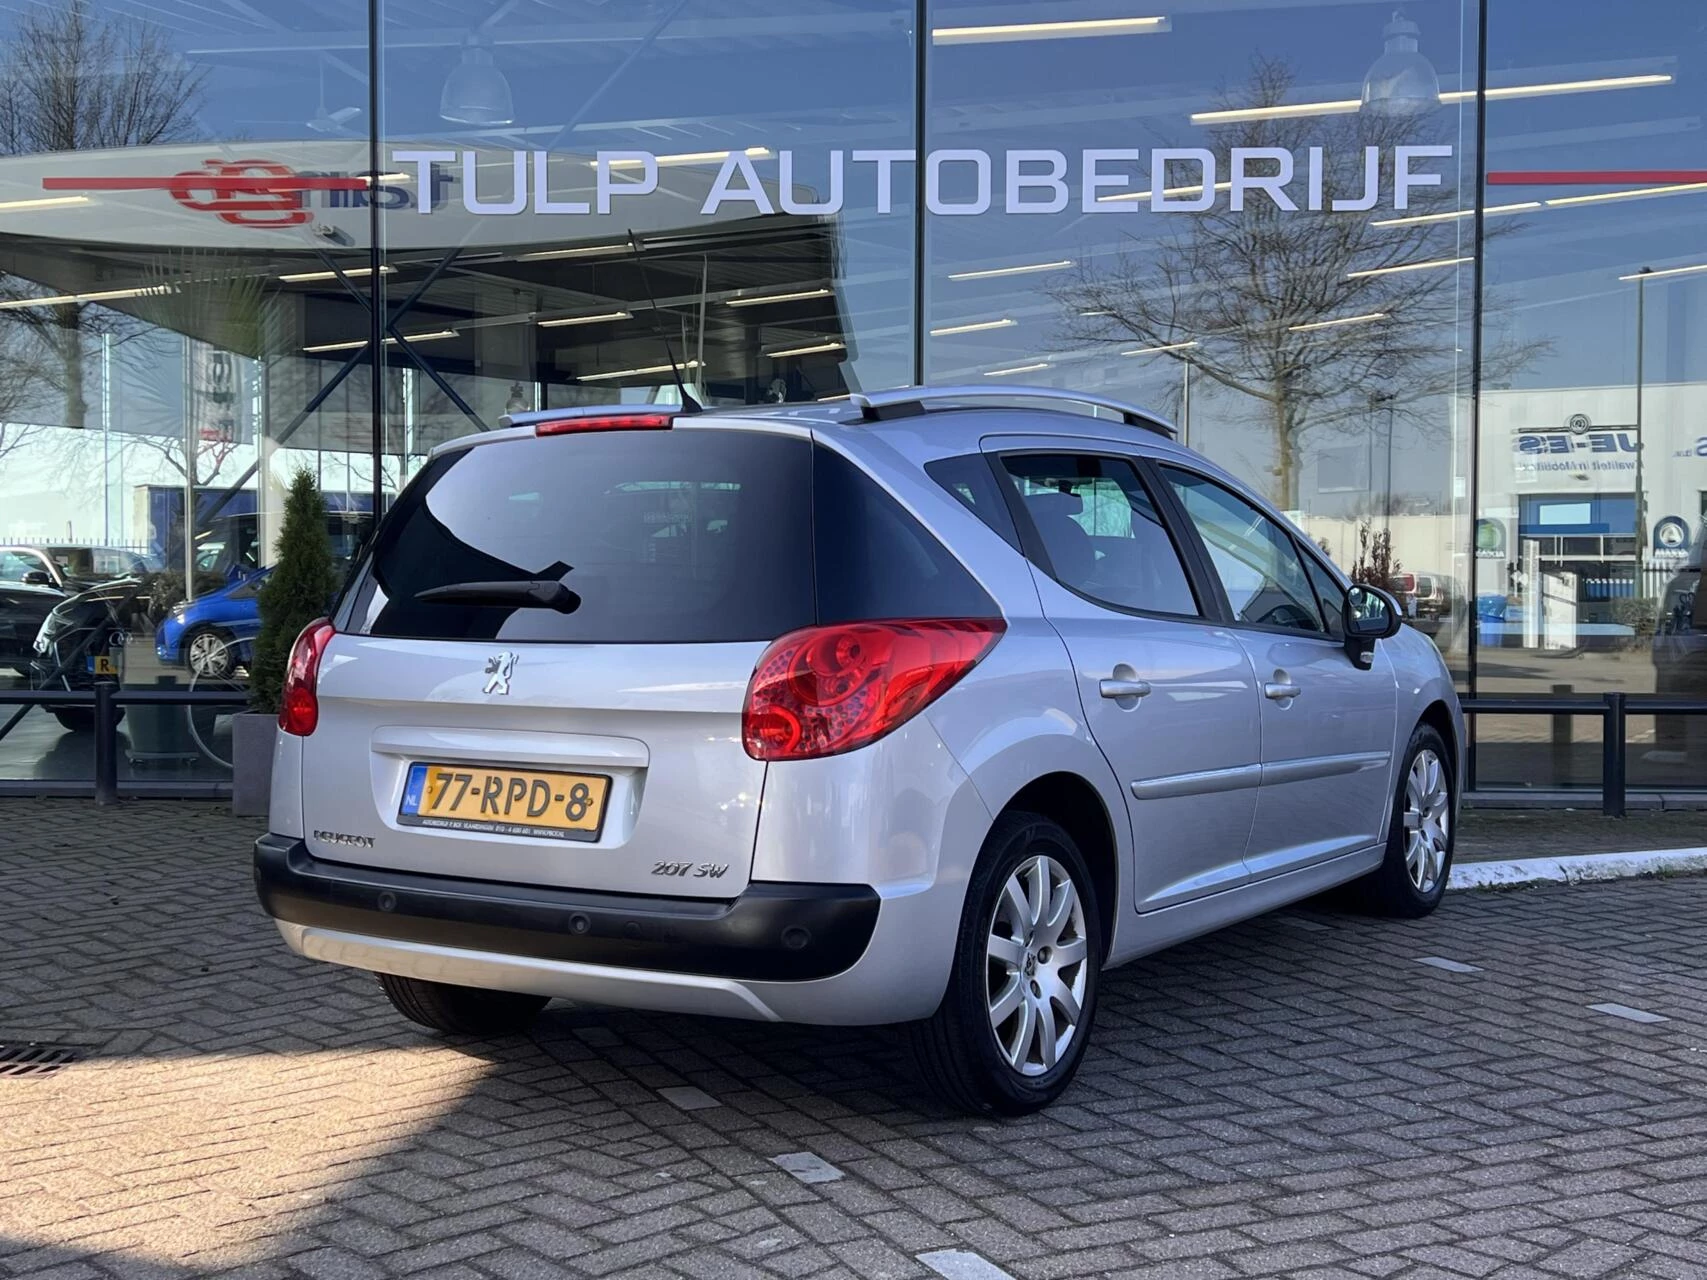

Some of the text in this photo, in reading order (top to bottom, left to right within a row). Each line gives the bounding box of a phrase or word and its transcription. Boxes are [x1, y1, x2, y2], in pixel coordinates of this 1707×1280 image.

[391, 144, 1453, 216] TULP AUTOBEDRIJF
[431, 772, 590, 822] 77-RPD-8
[651, 860, 729, 879] 207 SW
